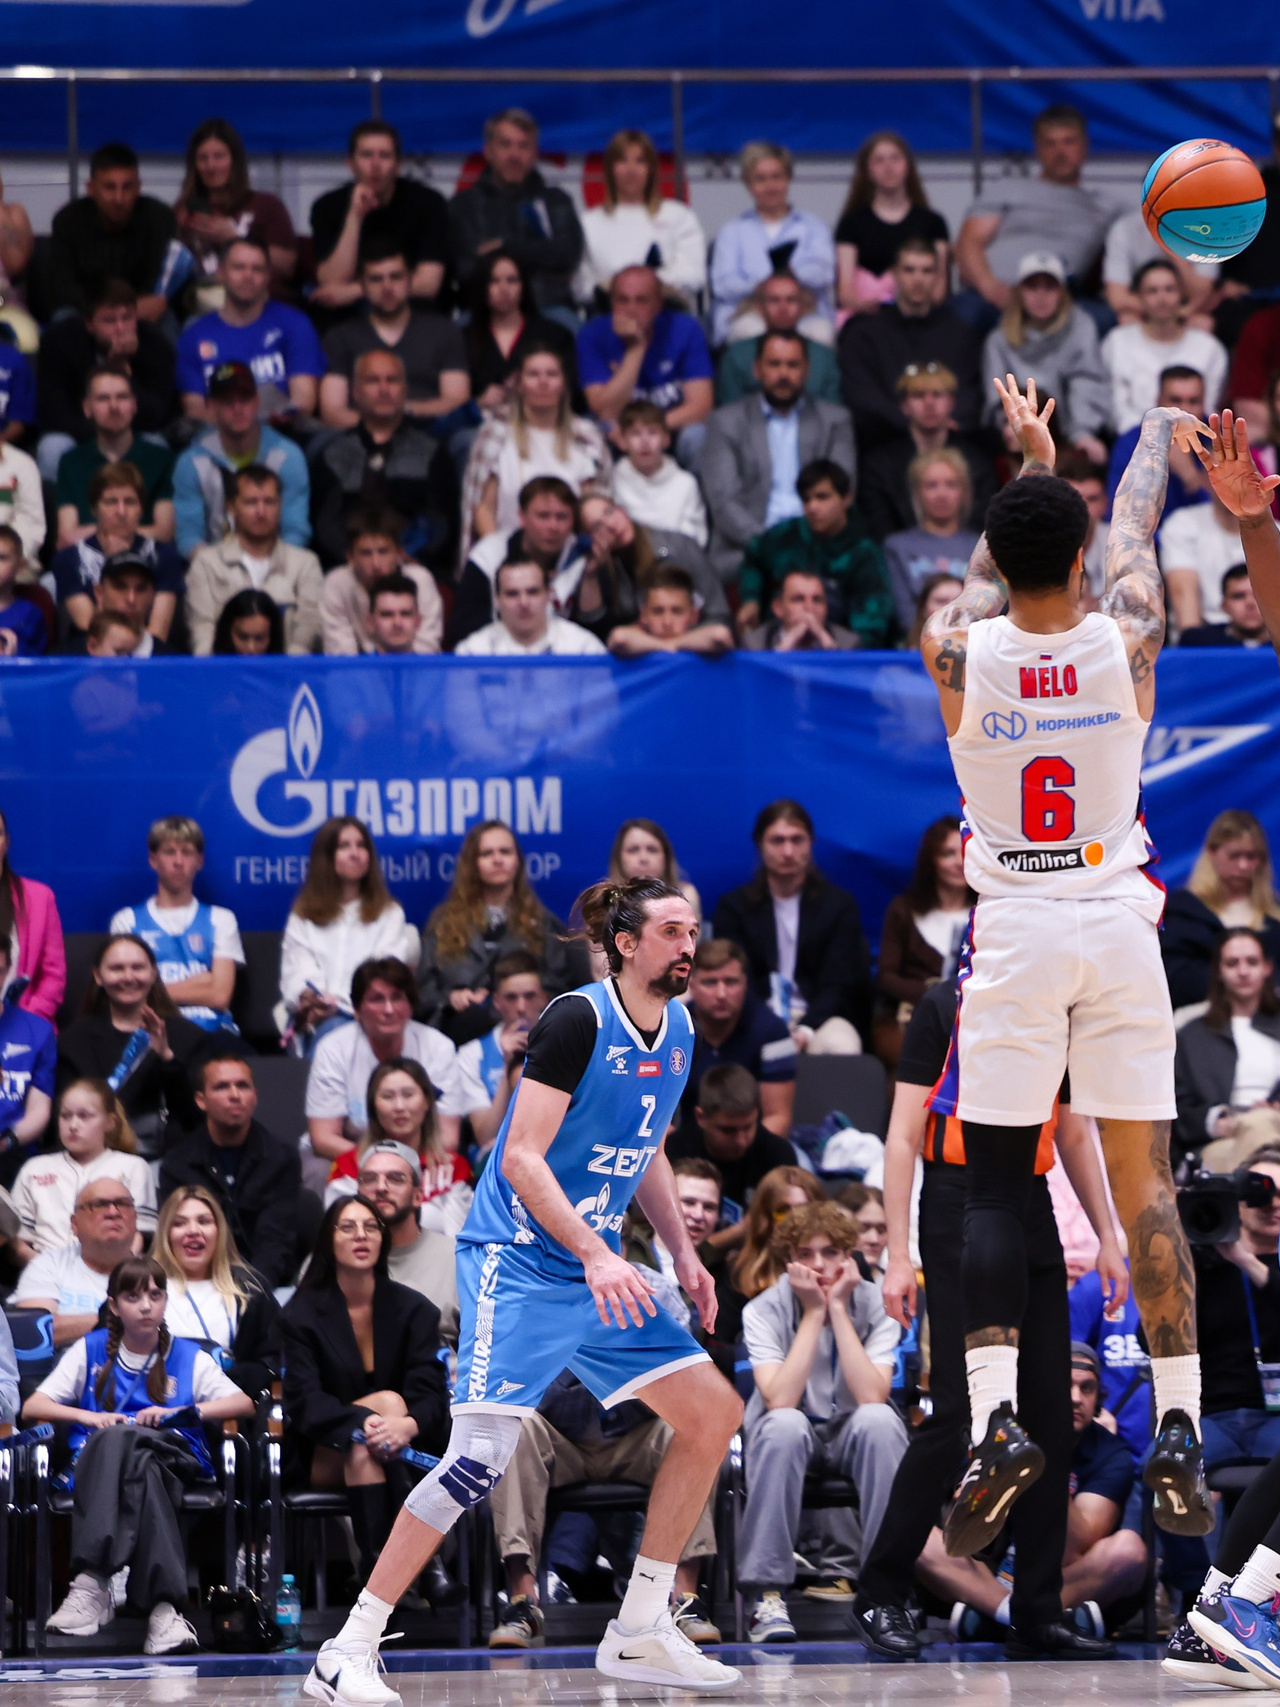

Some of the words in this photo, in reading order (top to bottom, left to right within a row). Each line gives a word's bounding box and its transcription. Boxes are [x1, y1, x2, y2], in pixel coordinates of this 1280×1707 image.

[1019, 664, 1078, 699] MELO
[1036, 711, 1121, 731] НОРНИКЕЛЬ
[331, 777, 562, 836] ГАЗПРОМ
[1021, 756, 1076, 842] 6
[1002, 852, 1078, 871] Winline
[638, 1094, 656, 1138] 2
